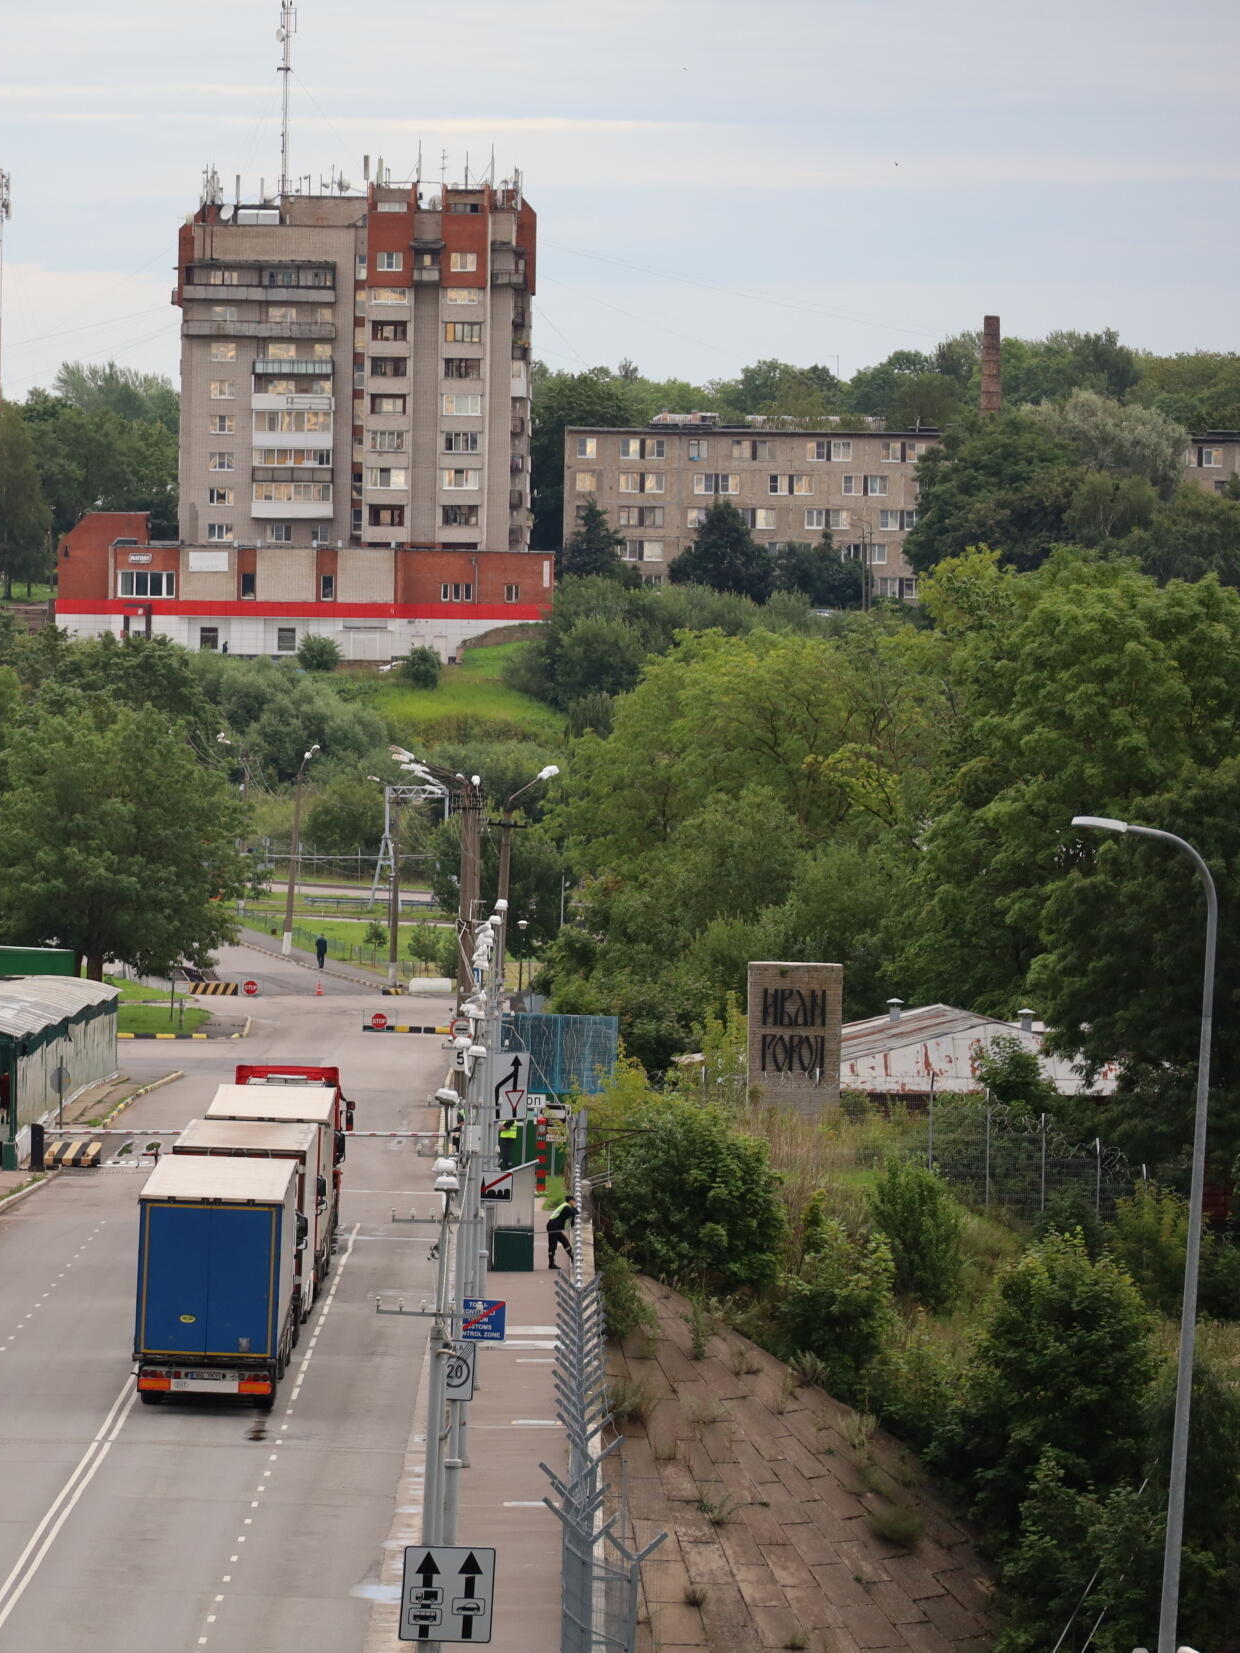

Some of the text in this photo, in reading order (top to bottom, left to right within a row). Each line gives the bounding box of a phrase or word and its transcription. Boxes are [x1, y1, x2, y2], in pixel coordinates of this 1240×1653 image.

[762, 988, 827, 1027] ИВАН
[371, 1017, 387, 1025] STOP
[456, 1051, 465, 1065] 5
[761, 1035, 825, 1079] ГОРОД
[446, 1364, 463, 1380] 20
